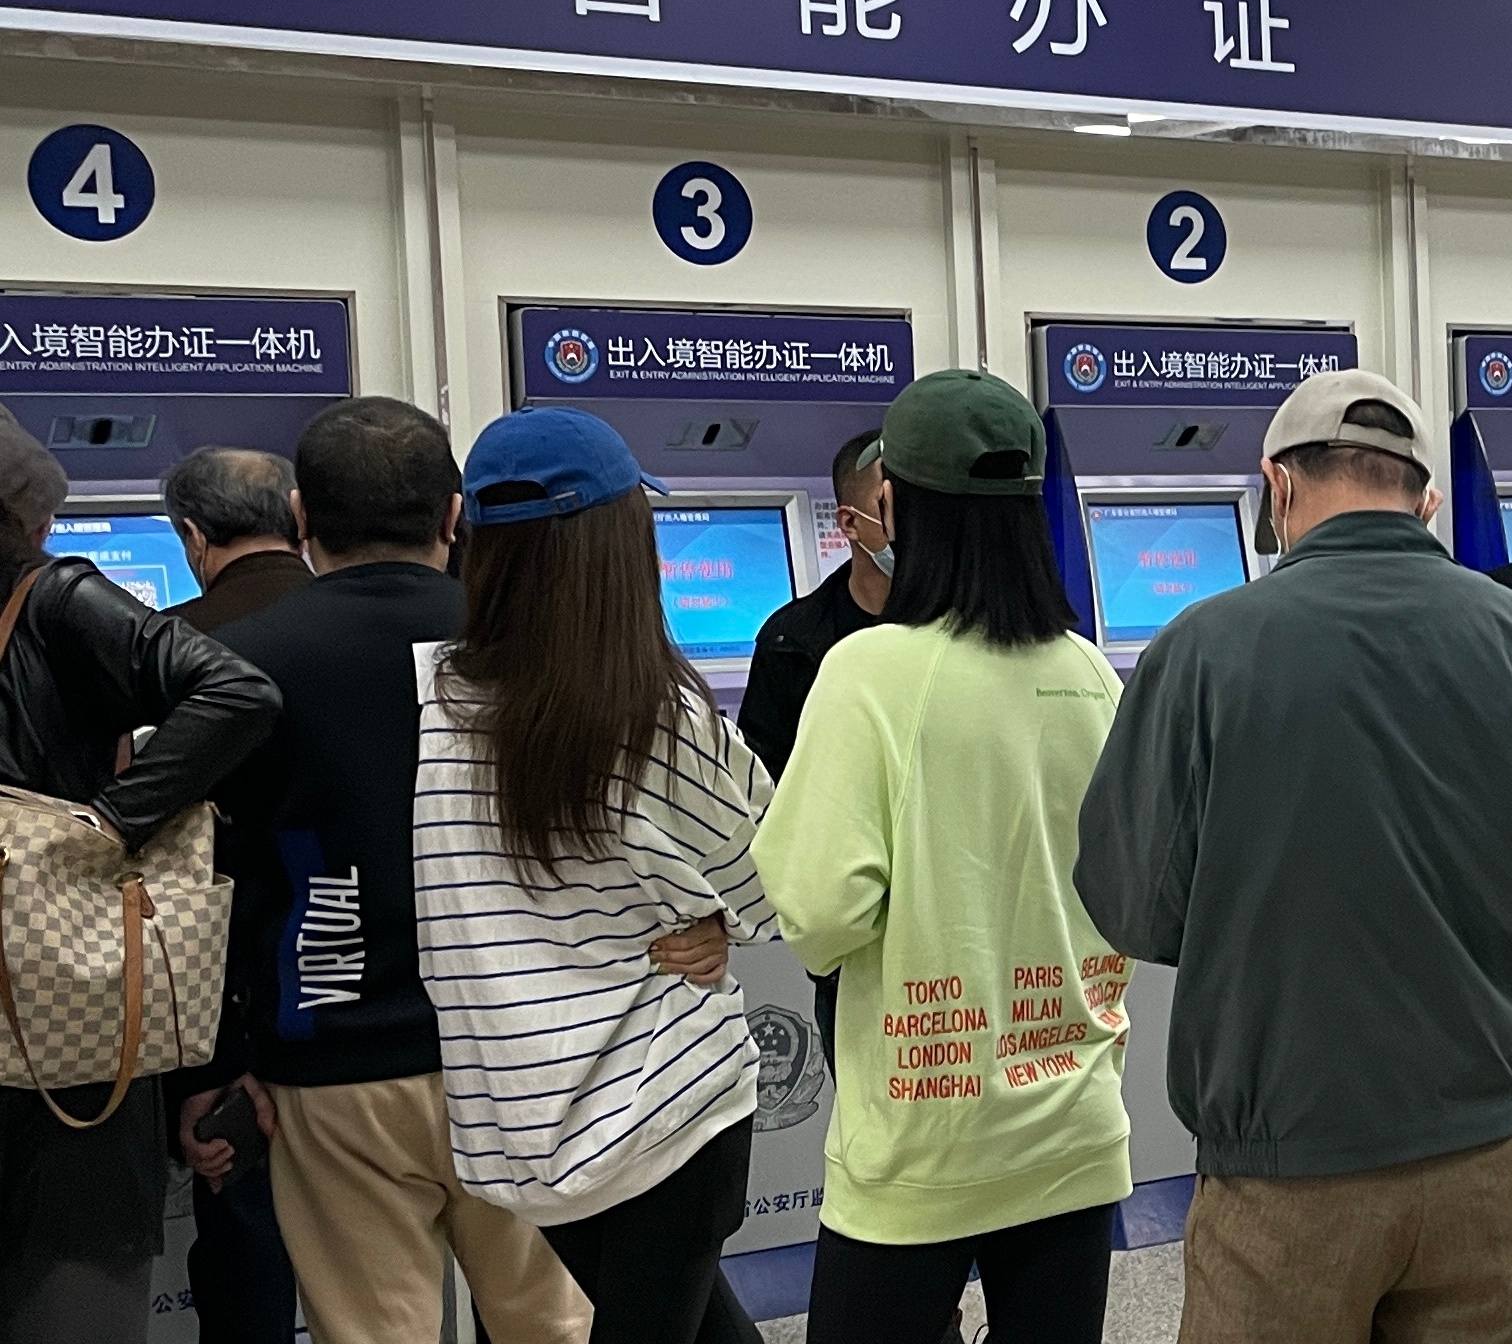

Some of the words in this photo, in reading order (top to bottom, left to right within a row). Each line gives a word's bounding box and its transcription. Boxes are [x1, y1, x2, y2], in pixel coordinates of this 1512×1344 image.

[62, 143, 125, 224] 4
[680, 178, 726, 250] 3
[1168, 205, 1208, 271] 2
[0, 323, 321, 360] 入境智能办证一体机
[608, 336, 894, 372] 出入境智能办证一体机
[297, 865, 365, 1010] VIRTUAL
[903, 975, 962, 1005] TOKYO
[1014, 966, 1063, 990] PARIS
[884, 1007, 988, 1038] BARCELONA
[1012, 997, 1062, 1023] MILAN
[897, 1041, 971, 1070] LONDON
[996, 1030, 1018, 1060] LOS
[1017, 1022, 1087, 1053] ANGELES
[1005, 1063, 1039, 1088] NEW
[1039, 1050, 1083, 1079] YORK
[888, 1074, 981, 1101] SHANGHAI
